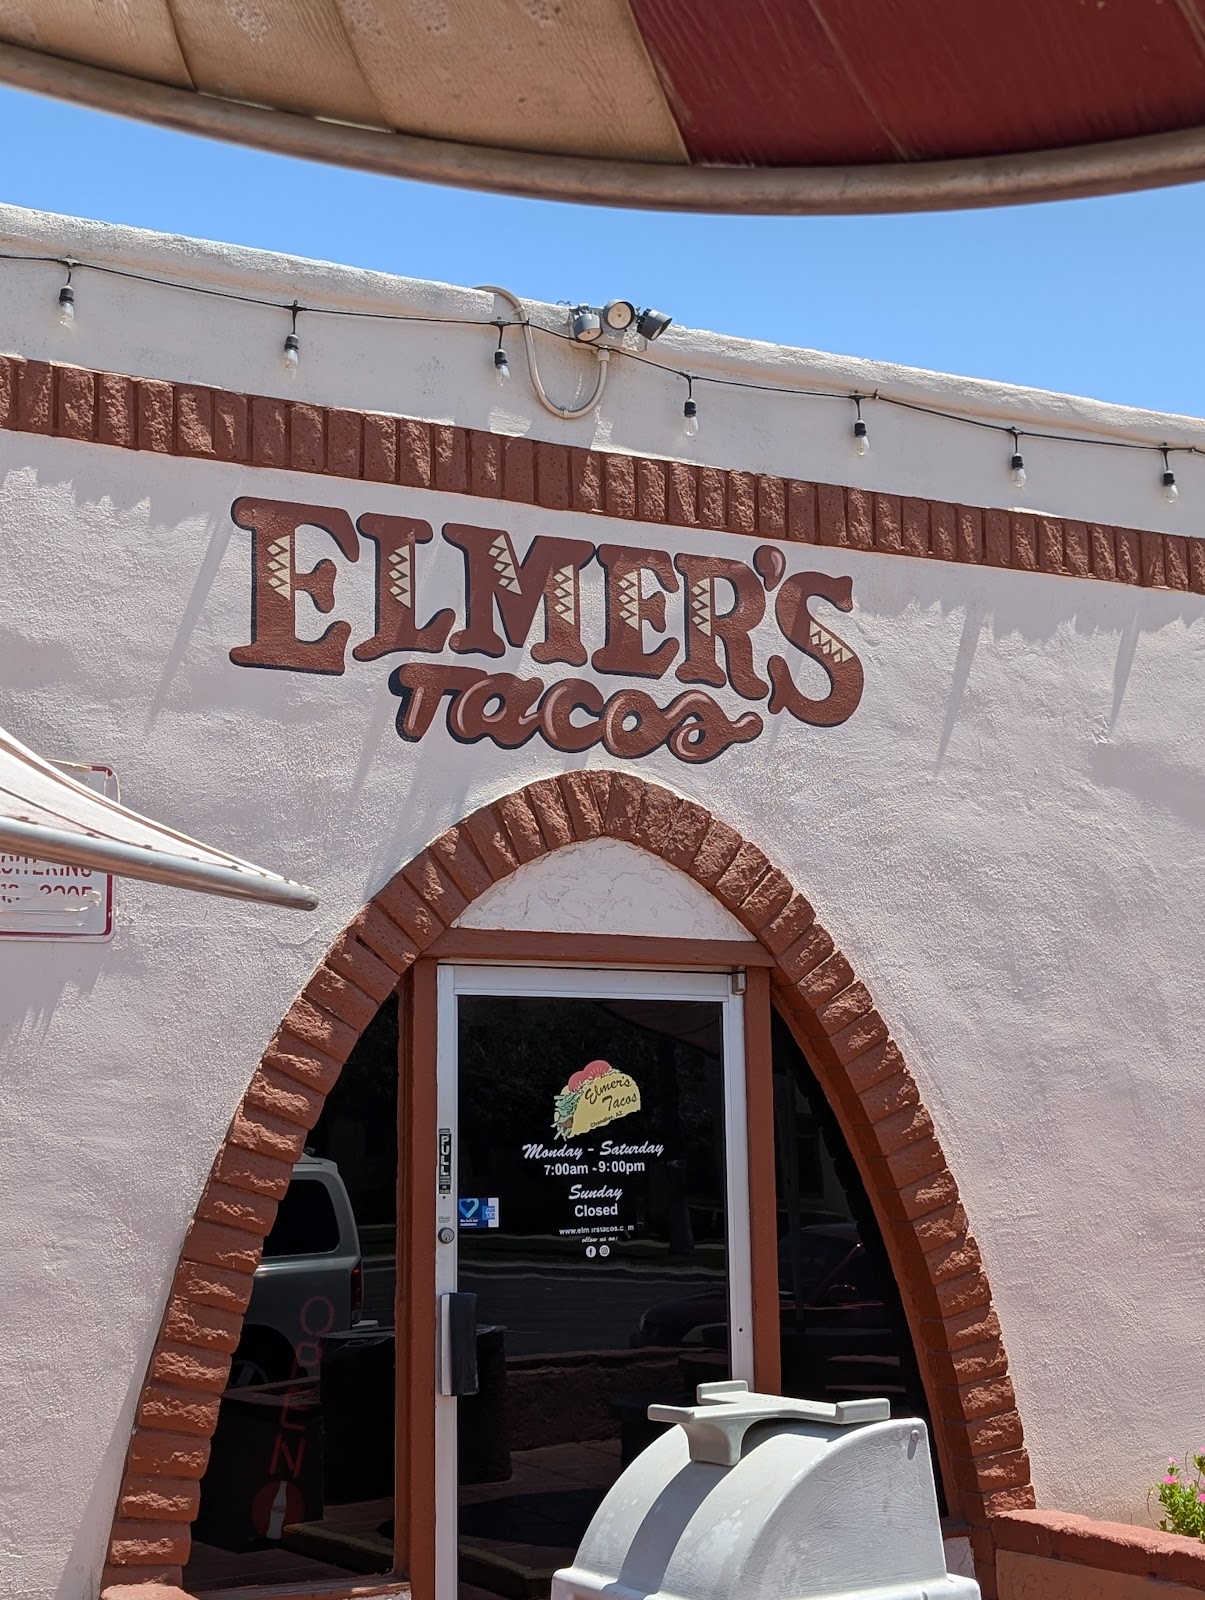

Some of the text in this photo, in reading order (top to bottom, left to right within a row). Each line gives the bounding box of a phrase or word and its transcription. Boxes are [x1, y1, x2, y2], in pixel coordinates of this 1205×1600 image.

[230, 496, 864, 728] ELMER'S
[389, 662, 763, 765] Tacos
[585, 1076, 632, 1105] Elmer's
[602, 1092, 638, 1111] Tacos
[440, 1135, 451, 1176] PULL
[522, 1143, 583, 1160] Monday
[599, 1140, 665, 1157] Saturday
[543, 1162, 589, 1176] 7:00am
[568, 1183, 624, 1201] Sunday
[574, 1203, 619, 1217] Closed
